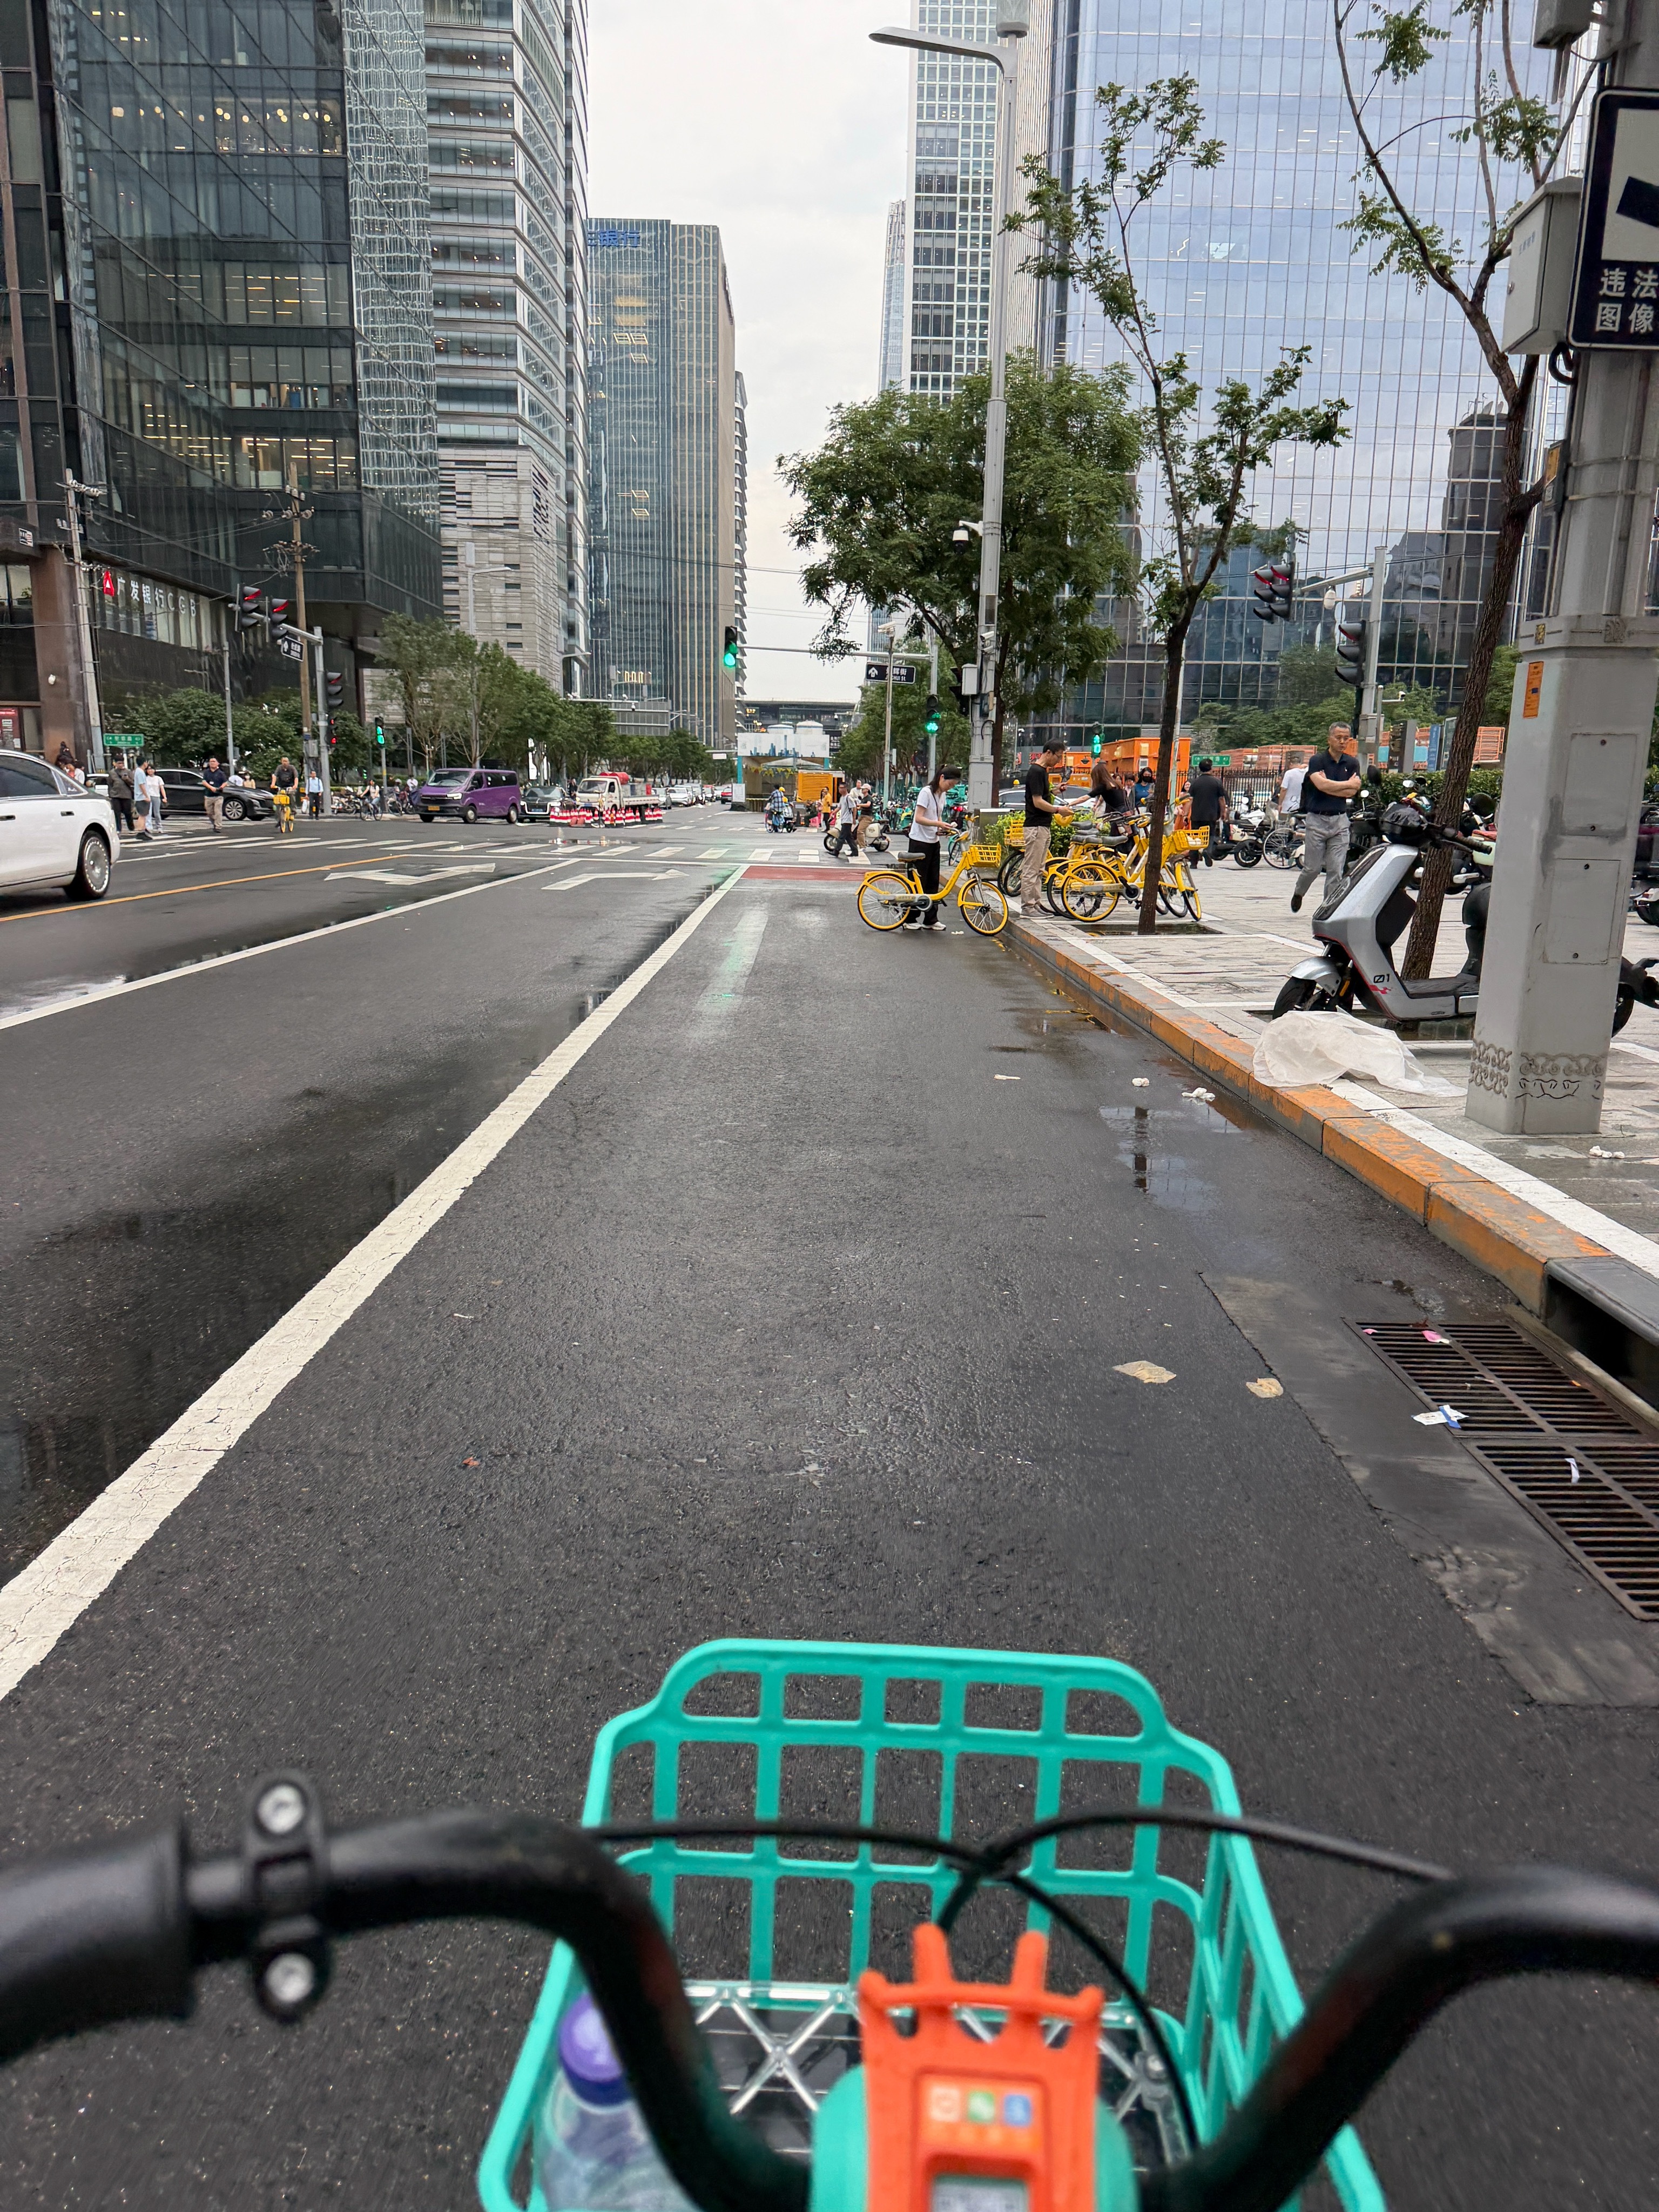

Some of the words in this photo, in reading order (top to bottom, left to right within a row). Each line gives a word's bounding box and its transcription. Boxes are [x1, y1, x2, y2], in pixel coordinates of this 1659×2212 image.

[1599, 268, 1659, 299] 违法
[1596, 303, 1654, 333] 图像
[117, 577, 164, 609] 广发银行
[167, 592, 196, 617] CGB
